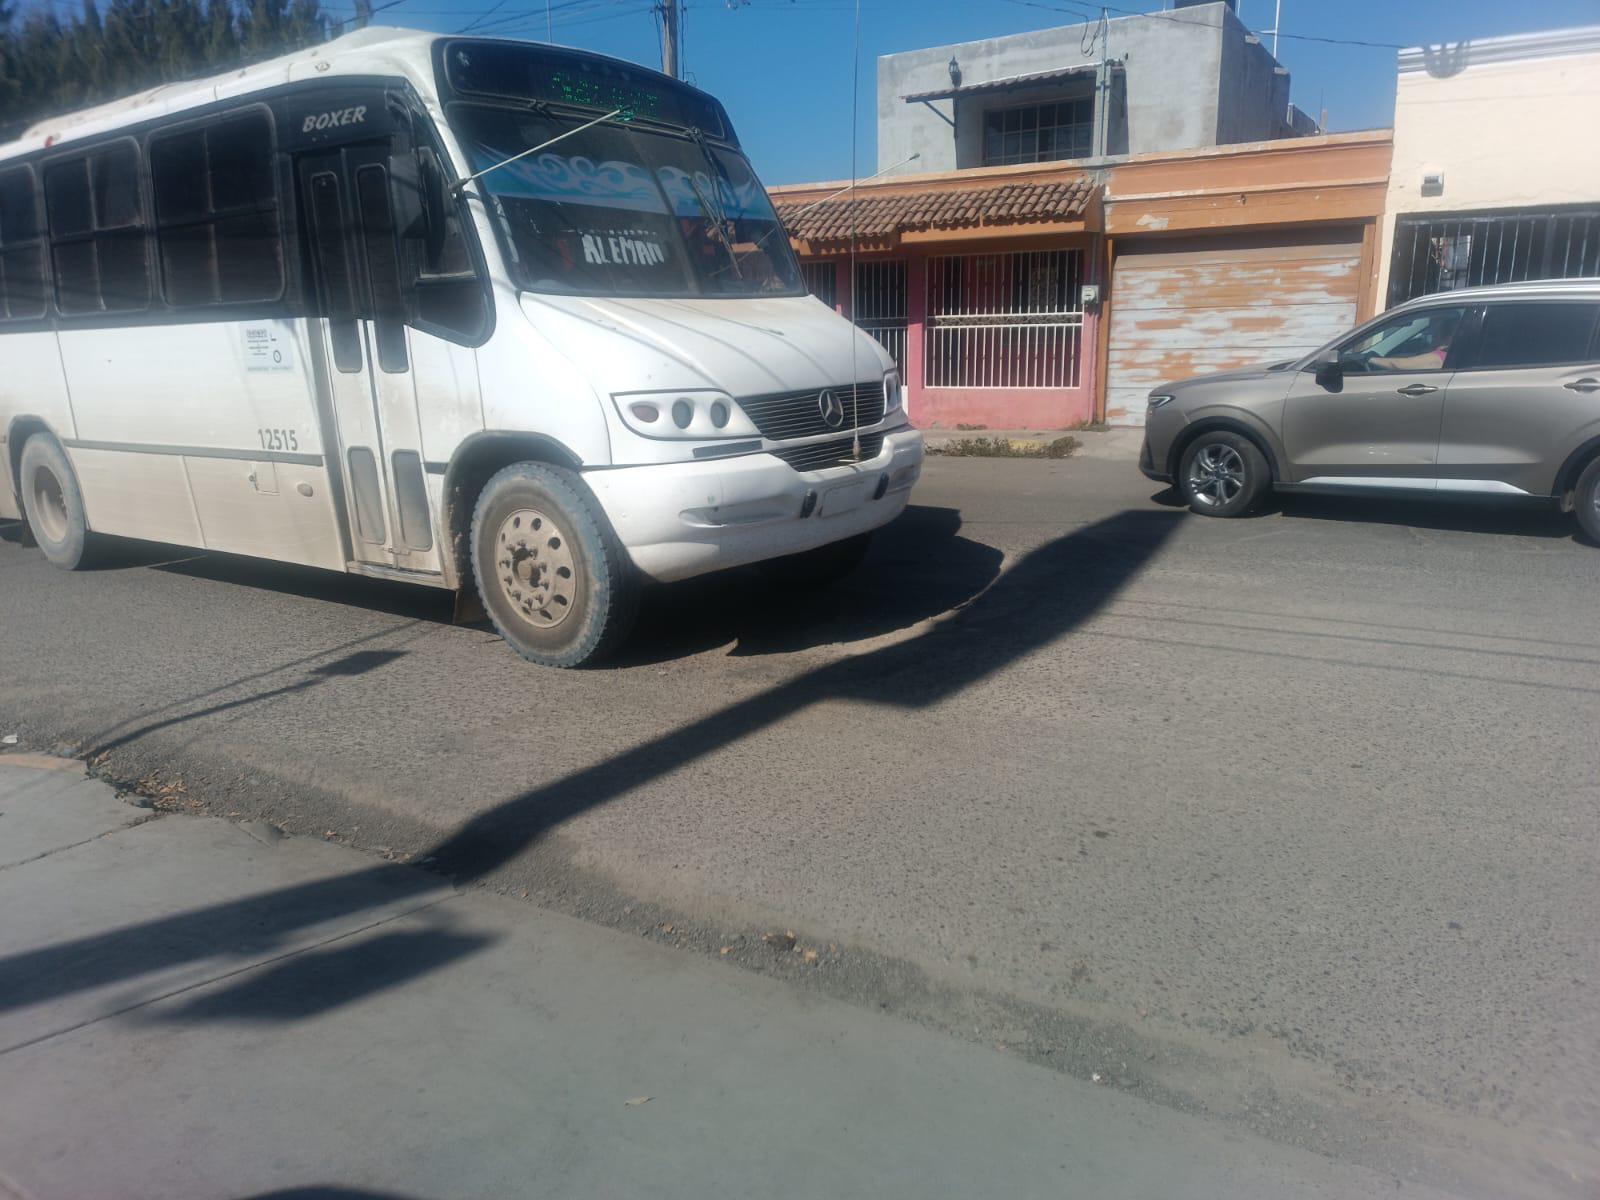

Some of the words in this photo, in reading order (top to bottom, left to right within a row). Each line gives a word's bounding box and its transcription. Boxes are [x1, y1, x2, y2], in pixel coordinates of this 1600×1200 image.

[302, 105, 367, 133] BOXER
[581, 233, 665, 266] ALEMAN
[257, 428, 298, 451] 12515
